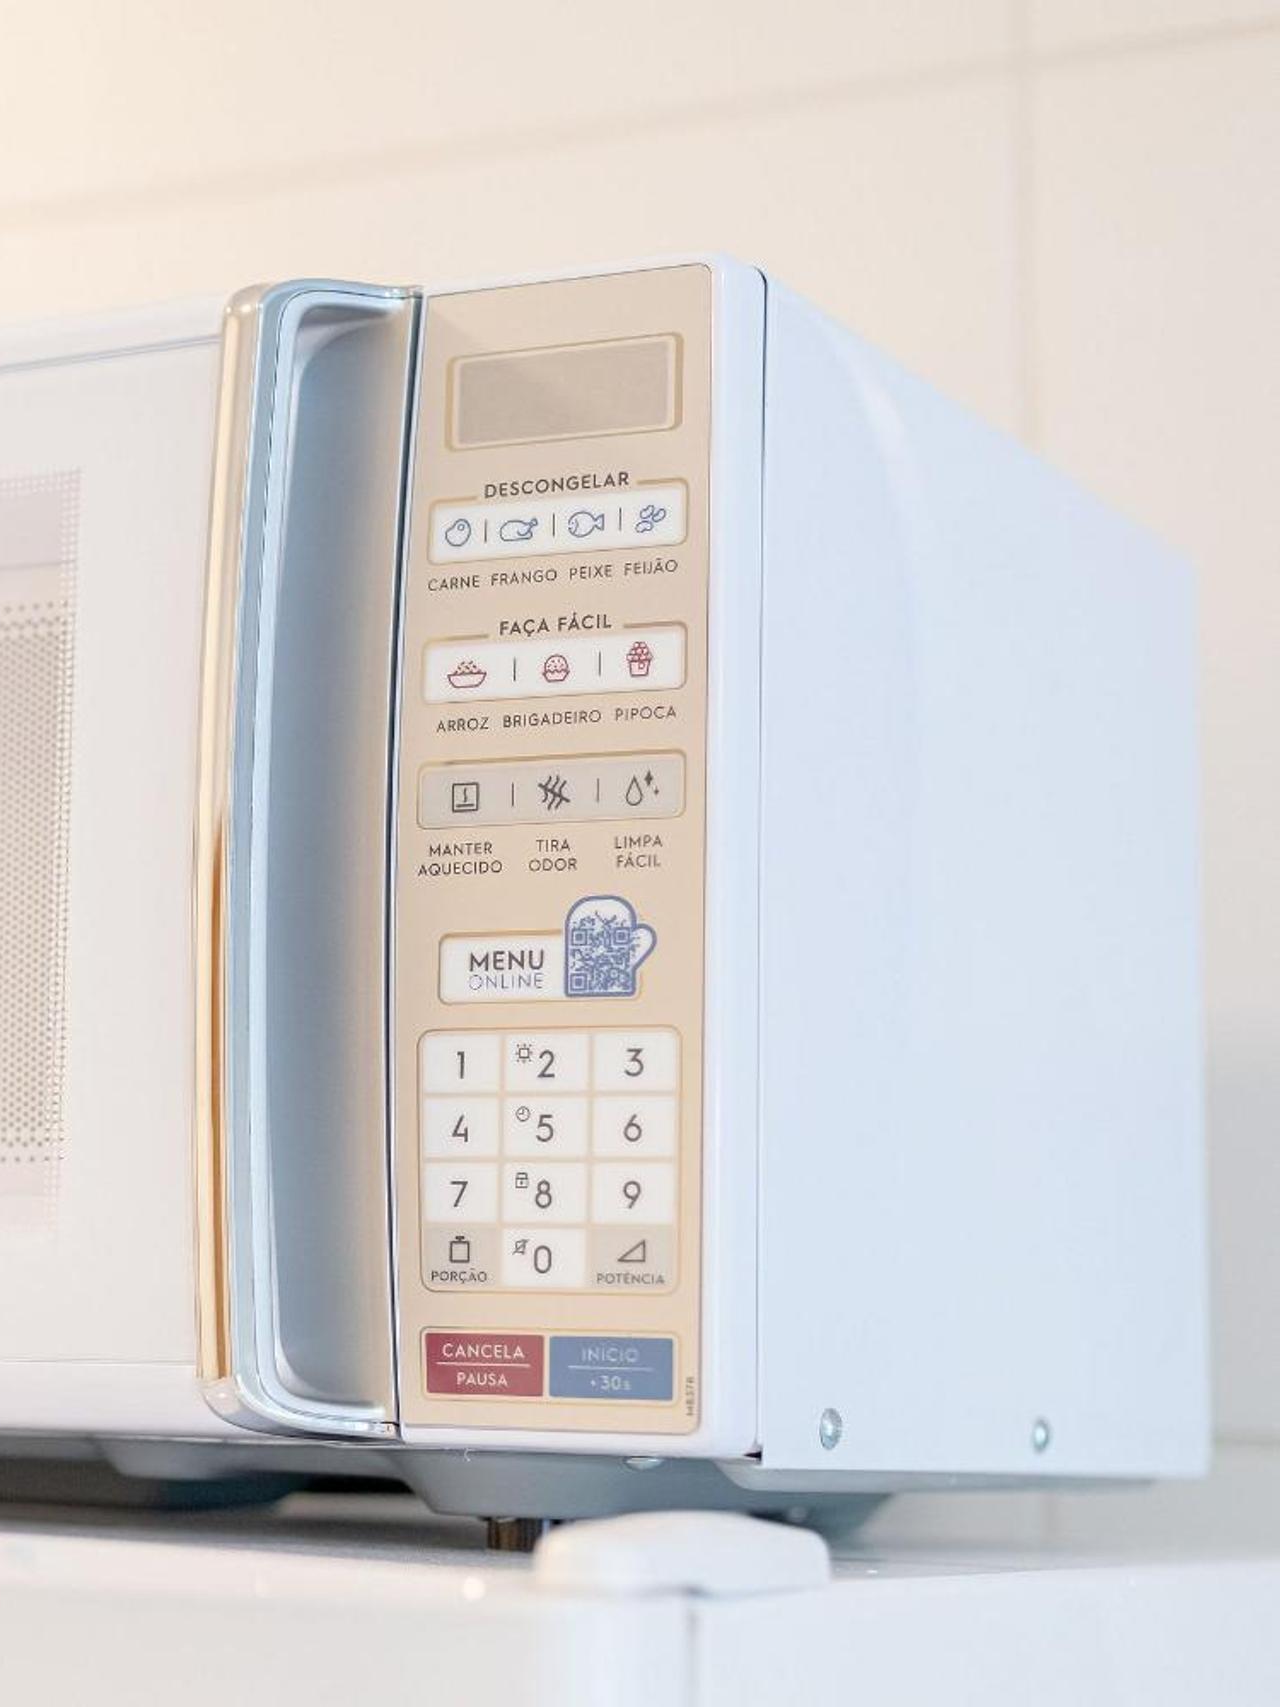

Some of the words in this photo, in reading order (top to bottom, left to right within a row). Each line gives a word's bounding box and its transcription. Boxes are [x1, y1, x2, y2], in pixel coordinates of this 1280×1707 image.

[483, 471, 630, 499] DESCONGELAR
[427, 575, 481, 592] CARNE
[490, 568, 558, 587] FRANGO
[569, 564, 614, 581] PEIXE
[623, 557, 679, 576] FEIJÃO
[499, 619, 551, 637] FAÇA
[557, 611, 613, 631] FÁCIL
[503, 709, 602, 729] BRIGADEIRO
[615, 704, 677, 721] PIPOCA
[436, 716, 490, 733] ARROZ
[429, 841, 493, 857] MANTER
[536, 838, 571, 852] TIRA
[614, 835, 663, 850] LIMPA
[418, 858, 503, 877] AQUECIDO
[528, 857, 578, 872] ODOR
[617, 852, 662, 869] FÁCIL
[469, 949, 545, 972] MENU
[470, 972, 545, 991] ONLINE
[456, 1051, 465, 1079] 1
[537, 1050, 556, 1079] 2
[624, 1048, 644, 1077] 3
[451, 1115, 469, 1143] 4
[535, 1114, 554, 1143] 5
[623, 1114, 643, 1143] 6
[450, 1180, 468, 1208] 7
[535, 1179, 552, 1209] 8
[623, 1180, 641, 1209] 9
[533, 1245, 552, 1274] 0
[431, 1268, 488, 1284] PORÇÃO
[442, 1343, 525, 1359] CANCELA
[581, 1343, 639, 1363] INÍCIO
[456, 1372, 508, 1386] PAUSA
